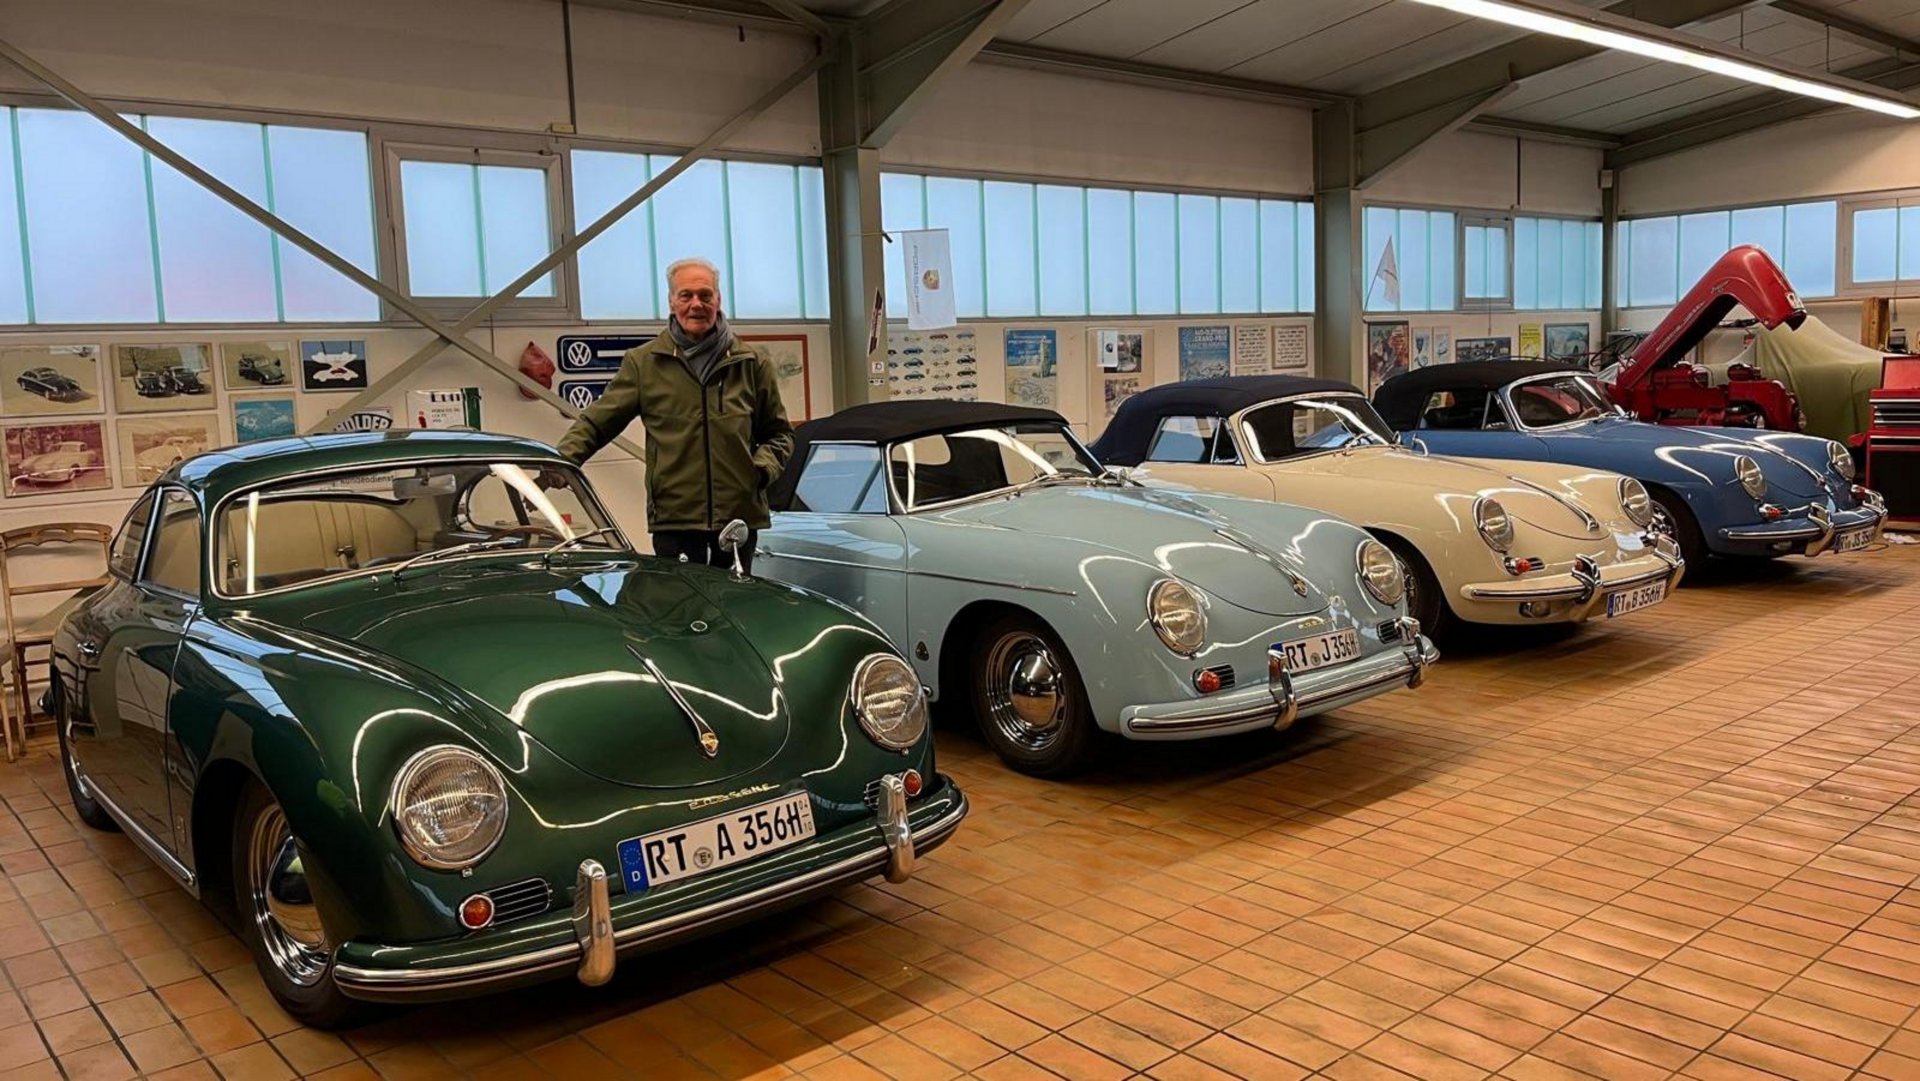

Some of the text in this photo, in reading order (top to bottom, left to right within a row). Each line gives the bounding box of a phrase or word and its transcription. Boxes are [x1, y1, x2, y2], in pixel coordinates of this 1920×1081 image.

[1614, 594, 1627, 614] RT
[1285, 632, 1358, 670] RT J 356H
[645, 801, 804, 879] RT A 356H
[631, 870, 642, 883] D
